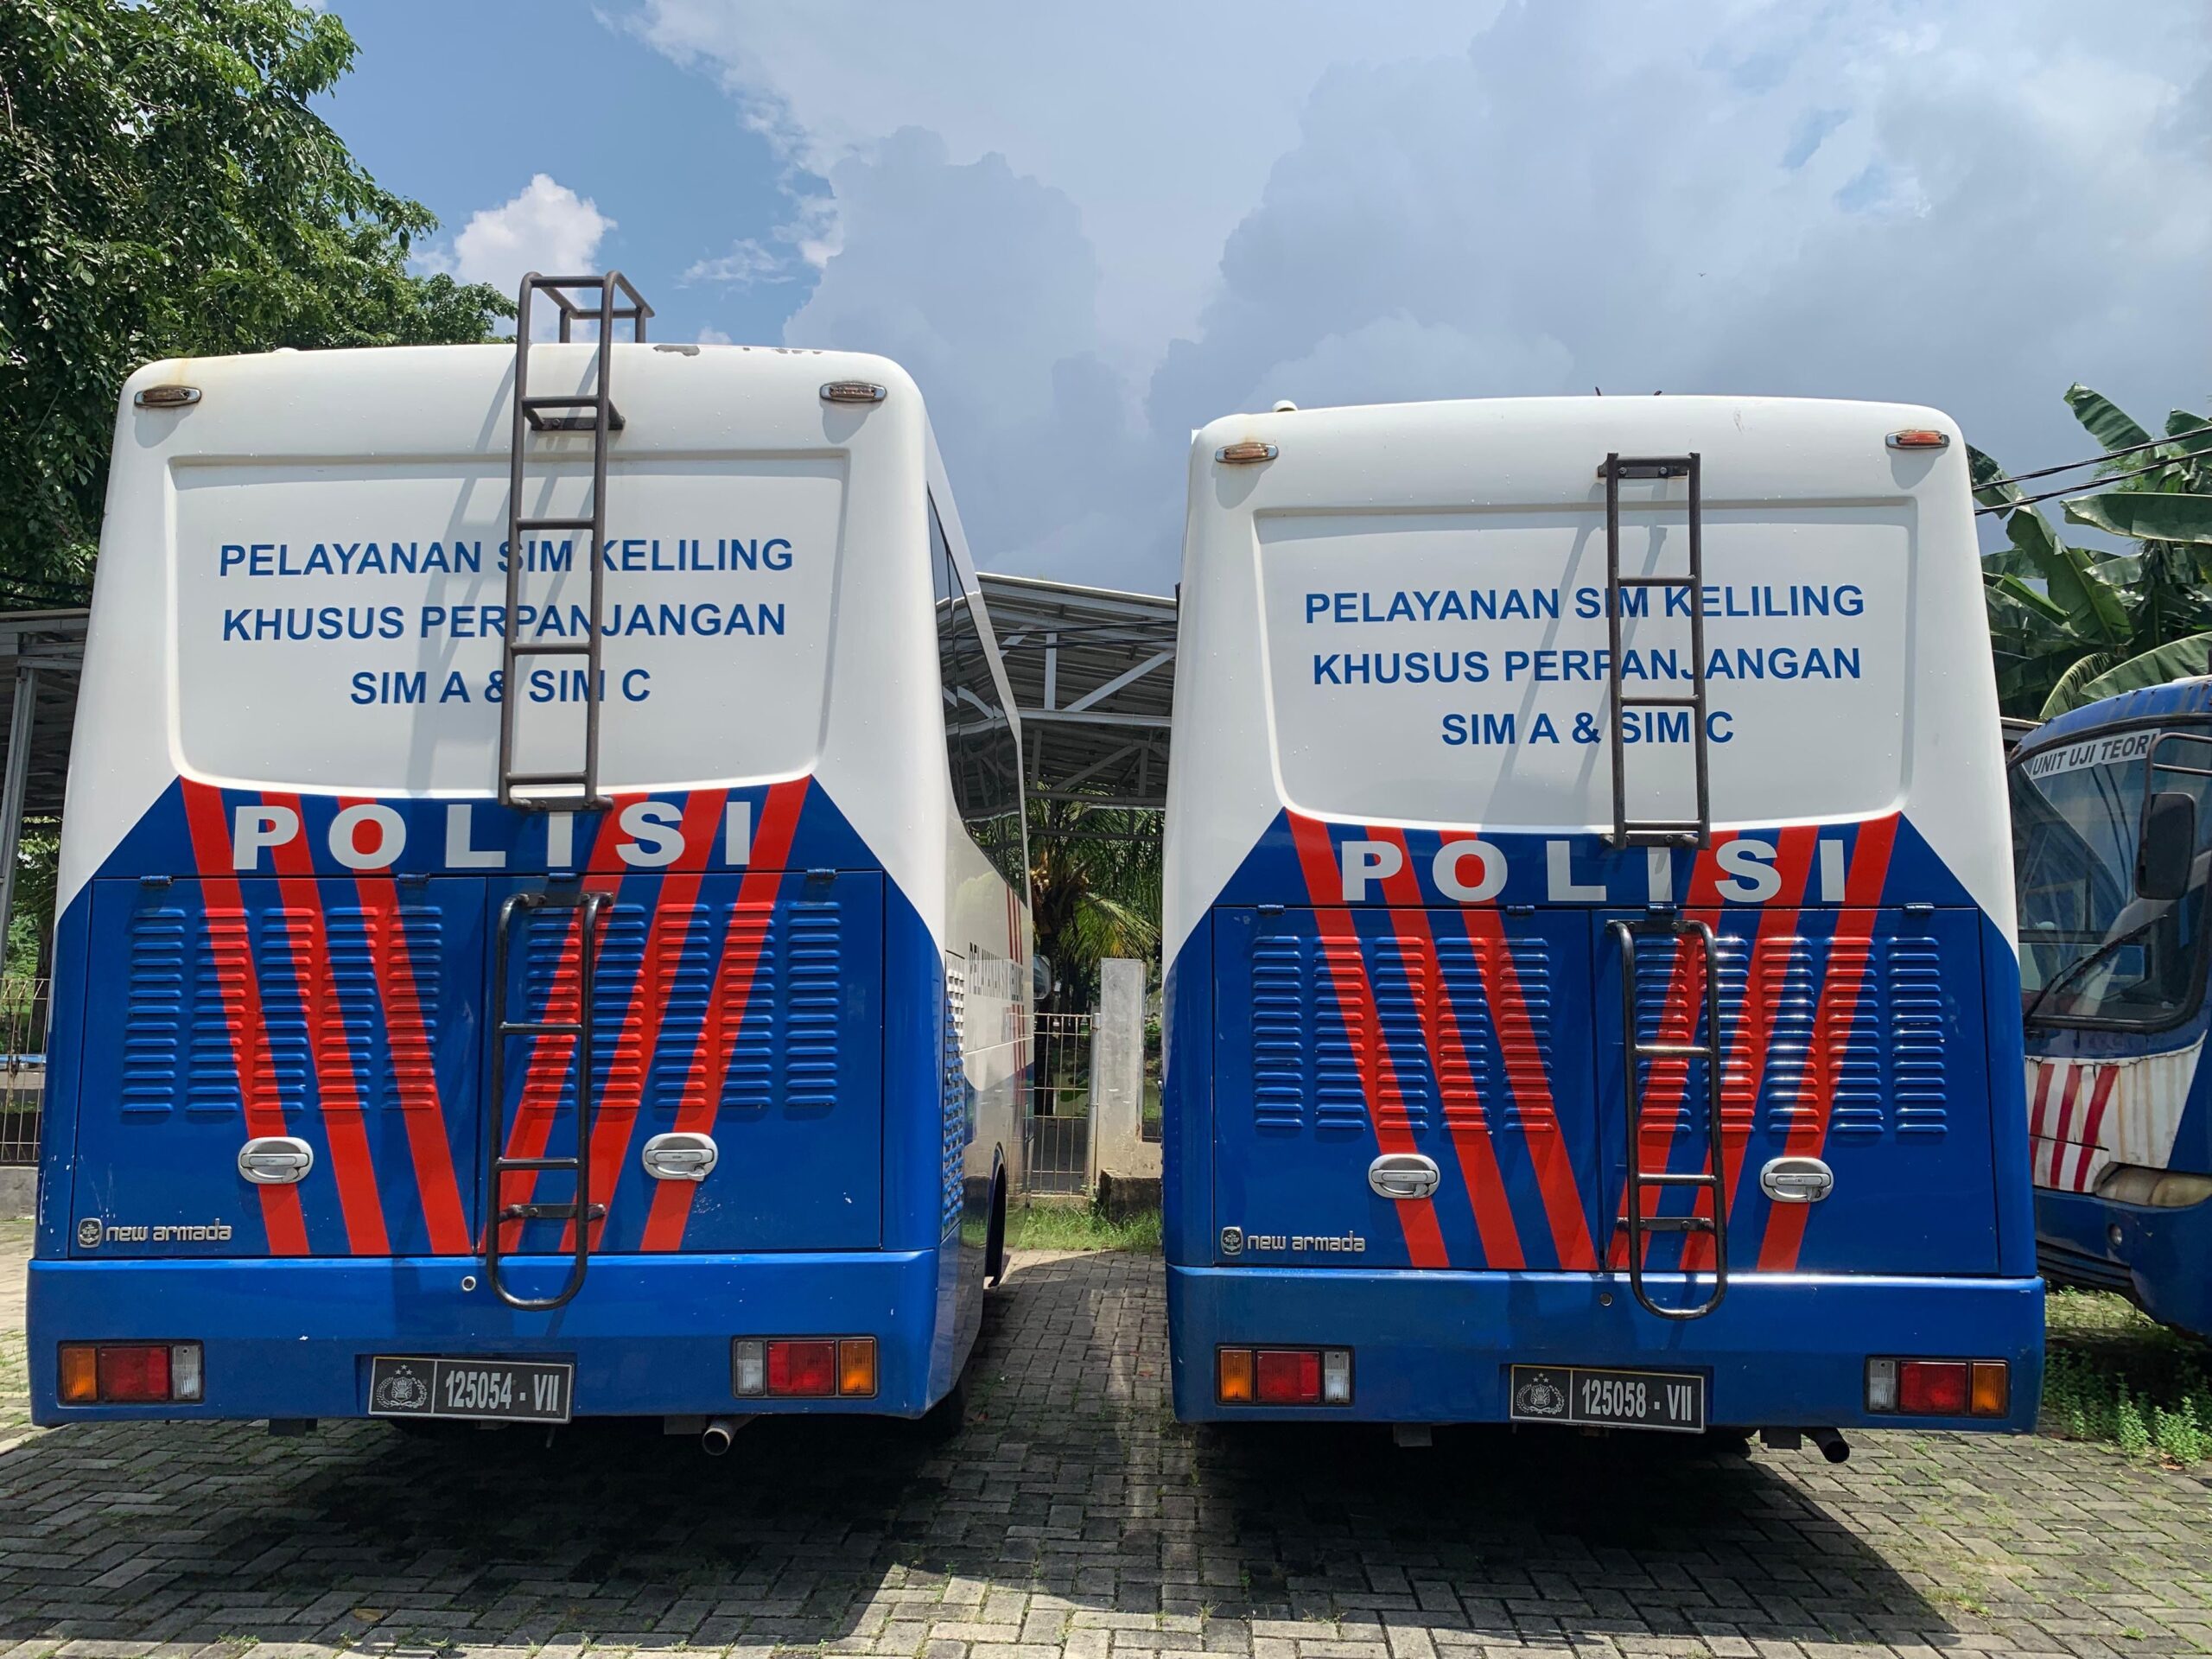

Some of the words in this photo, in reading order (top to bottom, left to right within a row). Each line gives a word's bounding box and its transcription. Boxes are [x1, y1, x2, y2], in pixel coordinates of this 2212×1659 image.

[219, 541, 482, 577] PELAYANAN
[497, 539, 573, 573] SIM
[222, 606, 404, 641] KHUSUS
[420, 603, 785, 639] PERPANJANGAN
[1305, 588, 1560, 624] PELAYANAN
[1664, 584, 1865, 619] KELILING
[350, 671, 427, 705] SIM
[440, 671, 471, 703] A
[483, 670, 504, 703] &
[529, 669, 605, 703] SIM
[621, 668, 651, 702] C
[1313, 650, 1491, 685] KHUSUS
[1441, 712, 1516, 747] SIM
[1529, 712, 1560, 745] A
[1571, 711, 1601, 745] &
[1621, 710, 1690, 744] SIM
[1706, 710, 1733, 744] C
[2032, 750, 2067, 776] UNIT
[2069, 743, 2096, 767] UJI
[232, 801, 752, 870] POLISI
[1341, 838, 1847, 903] POLISI
[105, 1225, 148, 1242] new
[152, 1217, 232, 1242] armada
[1247, 1235, 1287, 1250] new
[1291, 1230, 1366, 1252] armada
[446, 1370, 512, 1410] 125054
[533, 1374, 560, 1412] VII
[1581, 1378, 1647, 1418] 125058
[1666, 1384, 1692, 1421] VII
